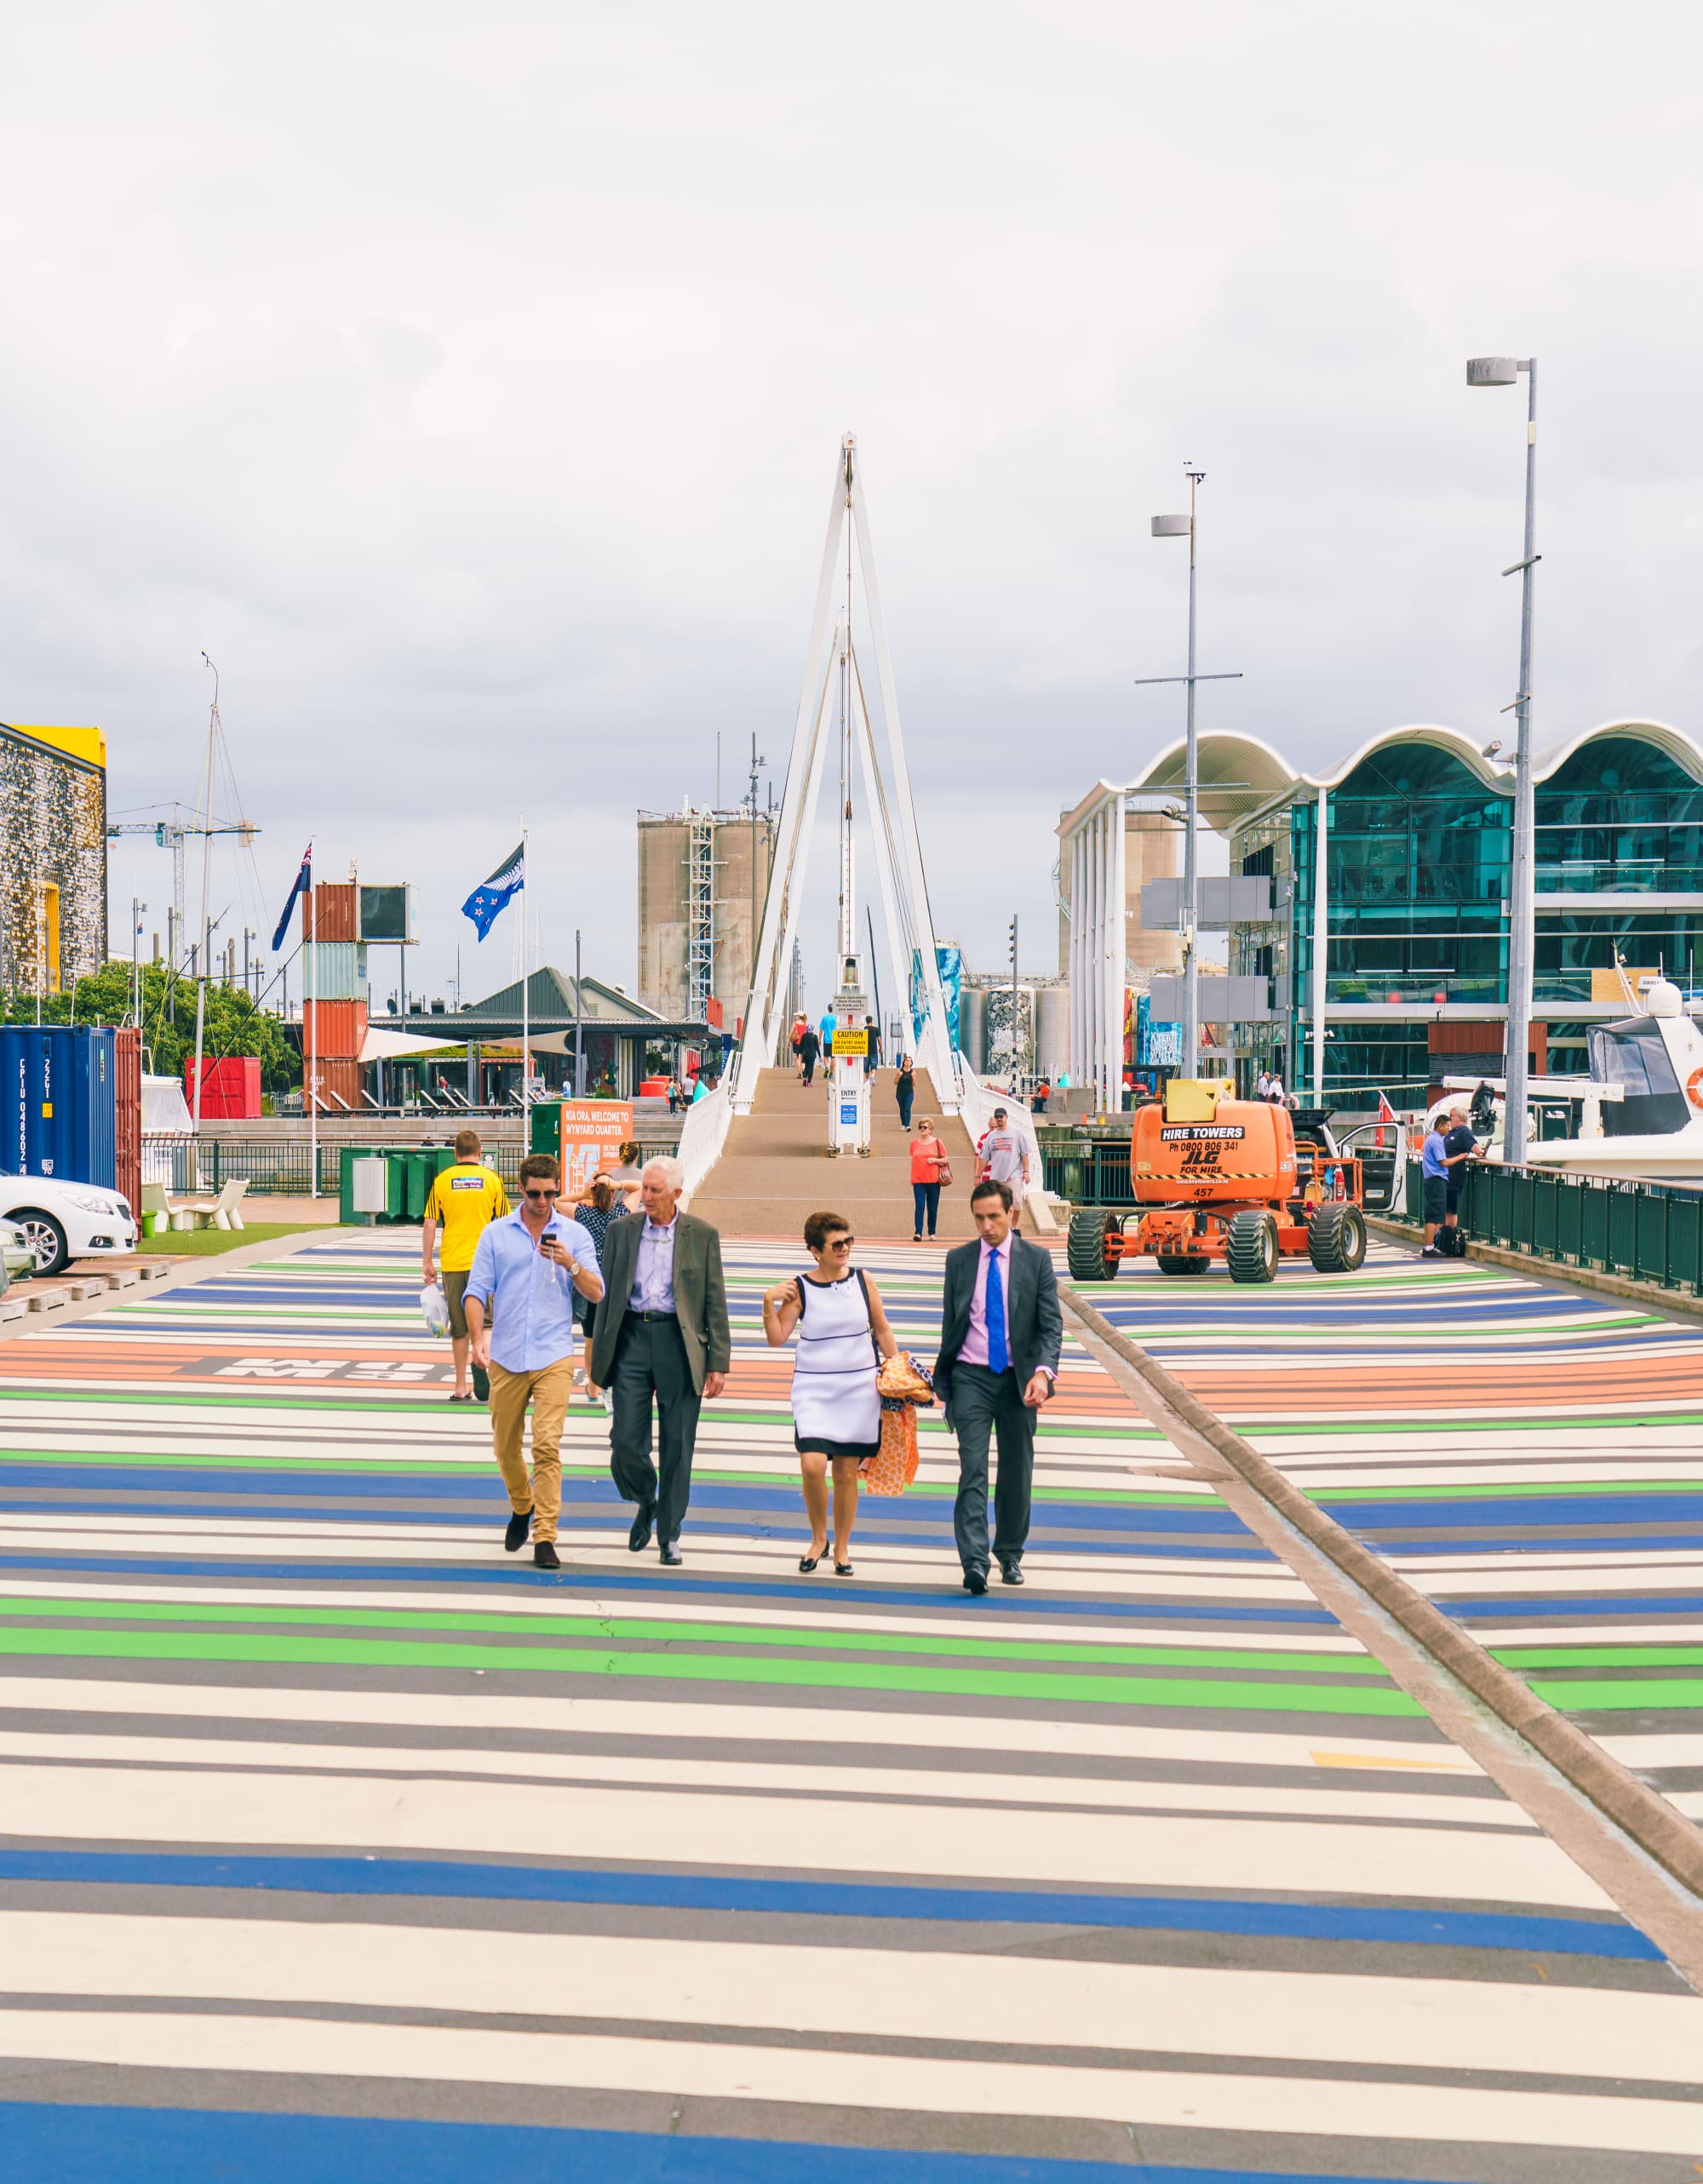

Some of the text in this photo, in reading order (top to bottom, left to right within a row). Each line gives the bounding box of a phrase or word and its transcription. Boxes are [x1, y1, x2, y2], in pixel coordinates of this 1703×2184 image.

[565, 1109, 629, 1123] KIA ORA, WELCOME TO
[565, 1123, 594, 1135] WYNYARD
[1162, 1126, 1242, 1140] HIRE TOWERS
[1169, 1142, 1239, 1152] Ph 0800 806 341
[1181, 1151, 1220, 1165] JLG
[1193, 1188, 1213, 1197] 457
